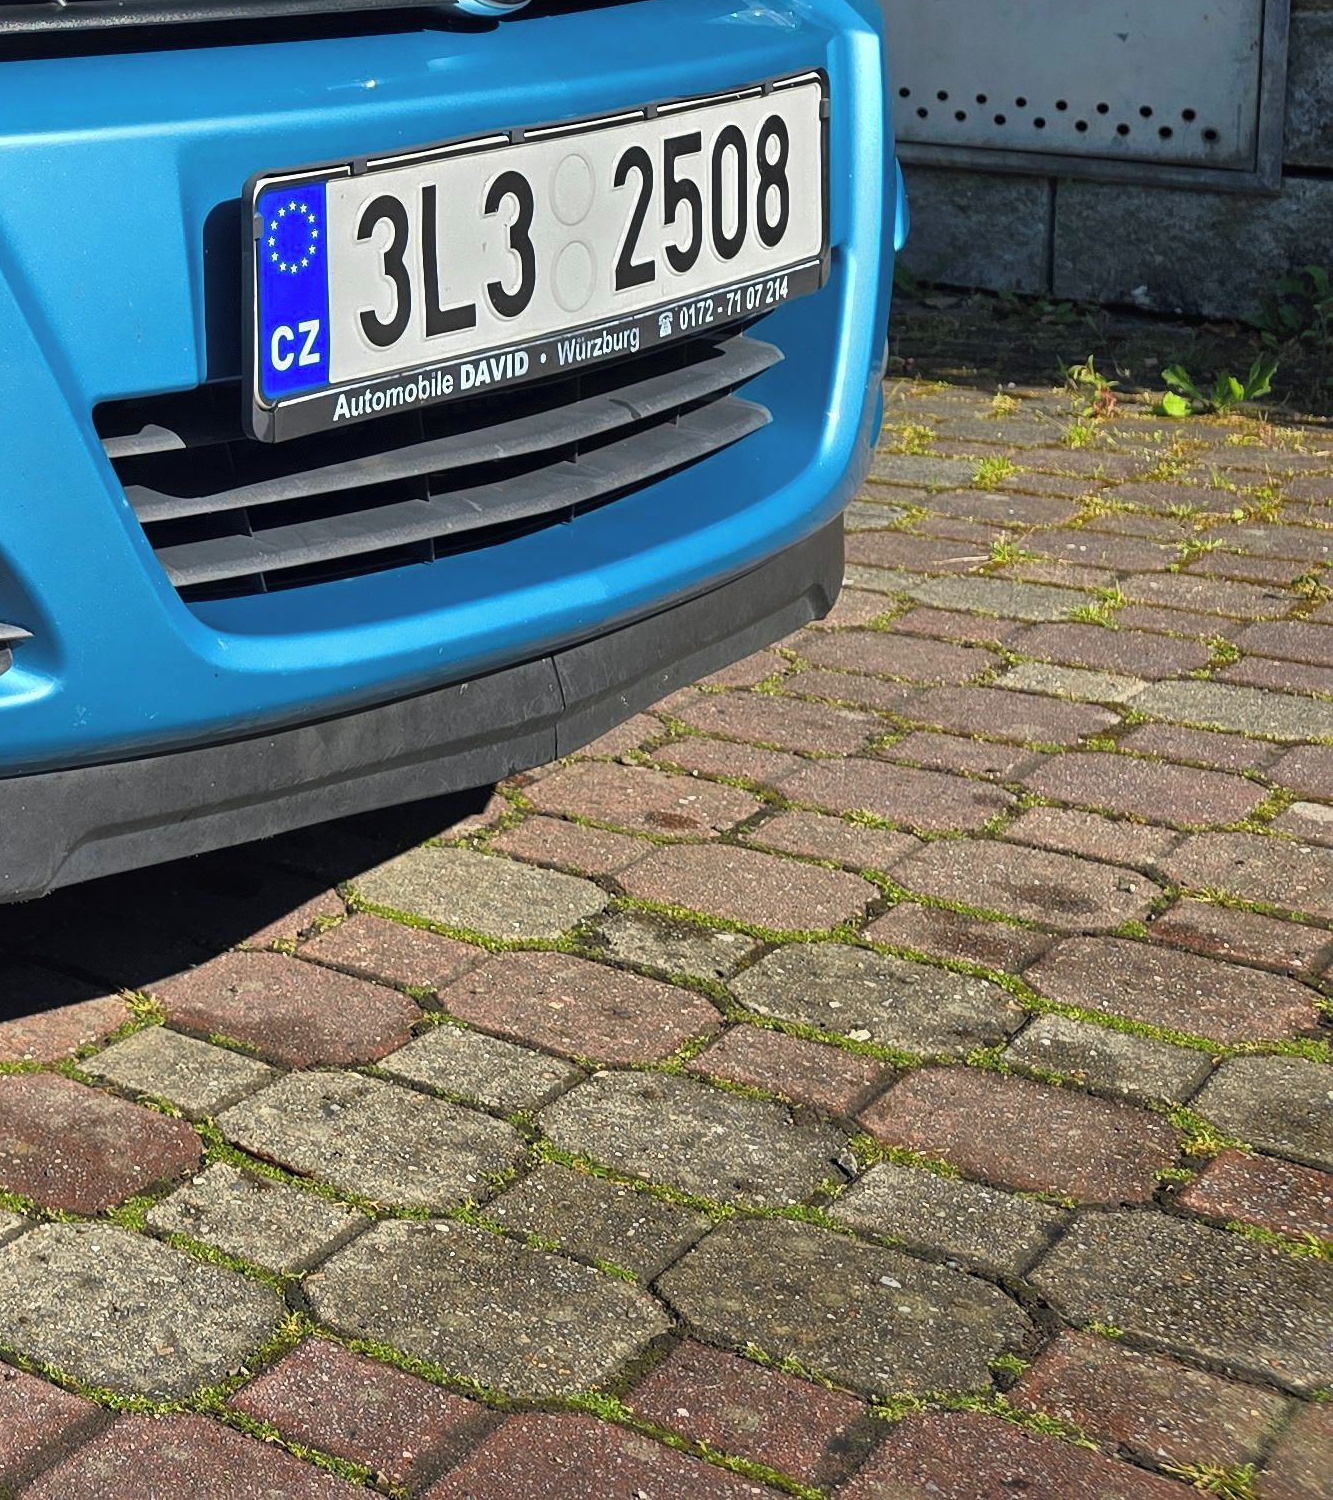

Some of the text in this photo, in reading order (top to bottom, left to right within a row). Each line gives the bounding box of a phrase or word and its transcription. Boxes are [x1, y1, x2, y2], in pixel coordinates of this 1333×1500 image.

[356, 115, 790, 347] 3L3 2508
[271, 319, 320, 371] CZ
[333, 370, 454, 421] Automobile
[460, 351, 529, 390] DAVID
[557, 327, 640, 366] Würzburg
[679, 299, 714, 331] 0172
[726, 291, 742, 316] 71
[746, 284, 763, 310] 07
[766, 276, 789, 302] 214
